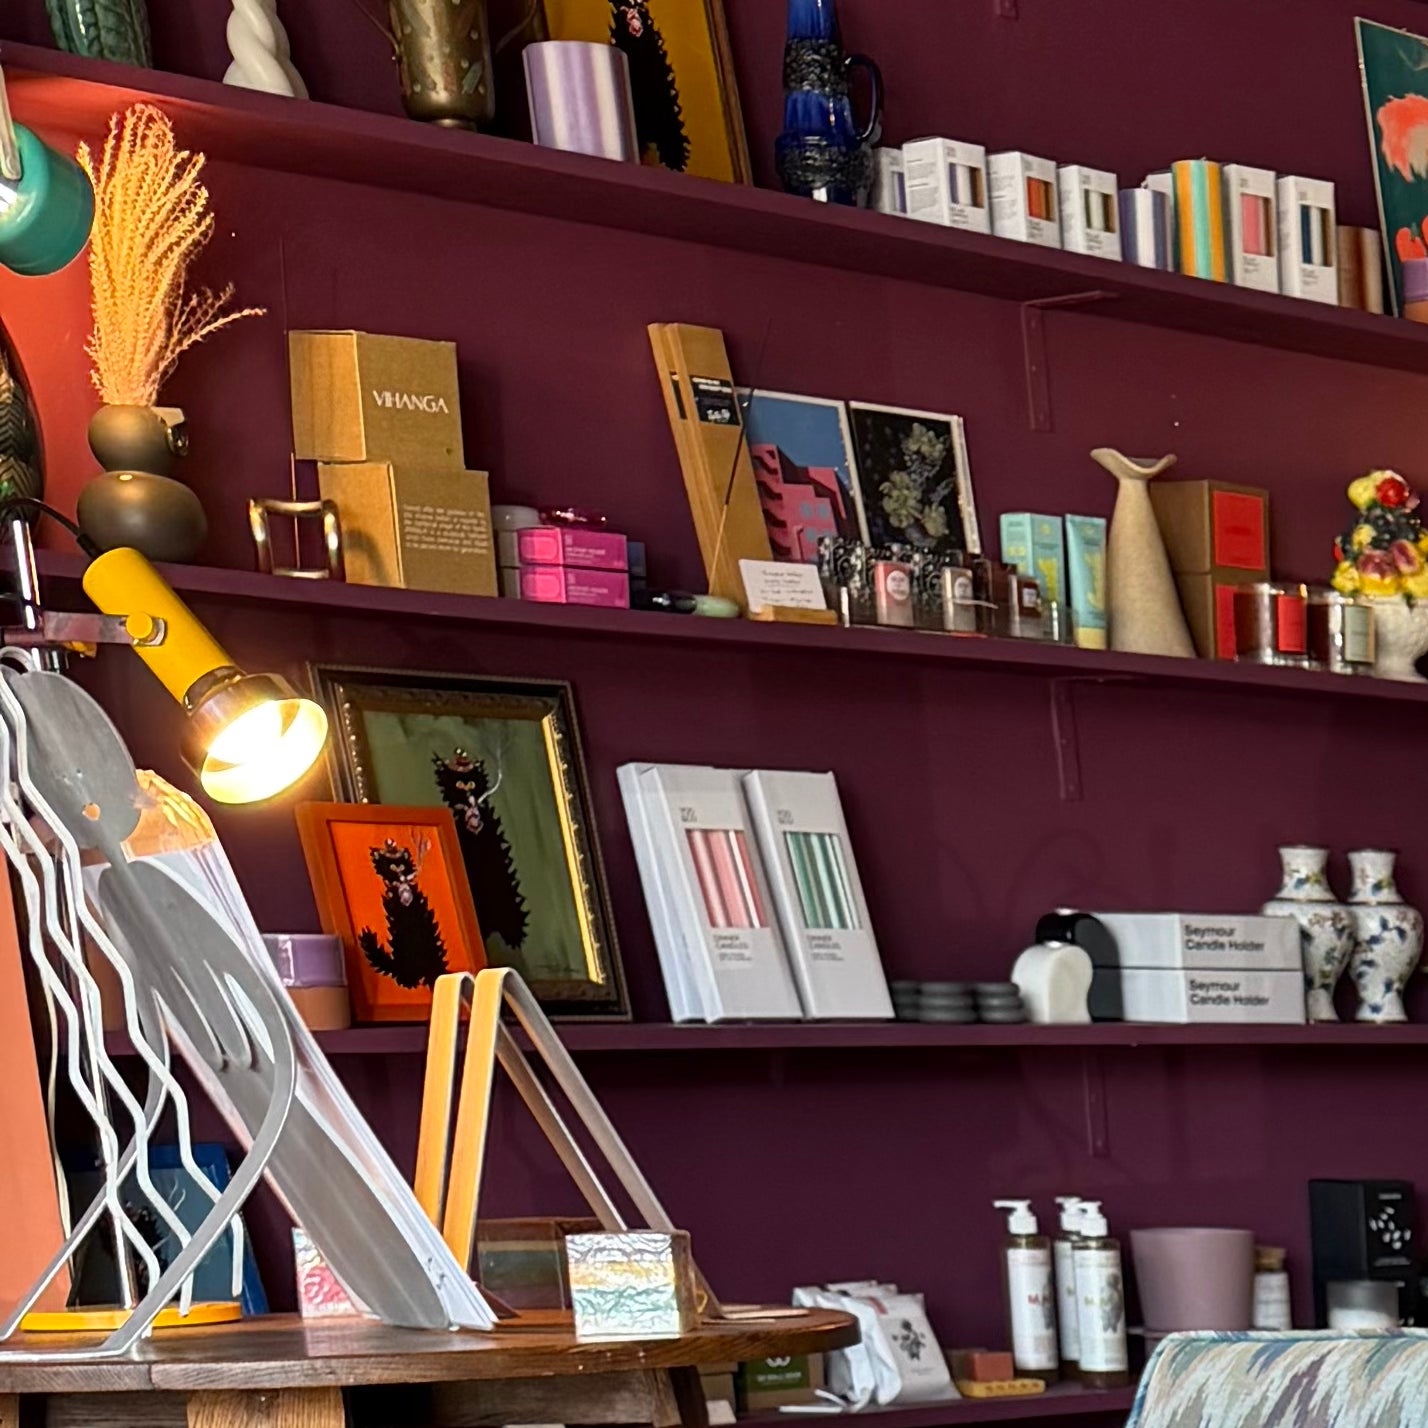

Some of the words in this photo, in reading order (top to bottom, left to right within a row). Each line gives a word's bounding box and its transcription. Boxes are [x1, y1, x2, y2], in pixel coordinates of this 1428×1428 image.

[372, 390, 449, 414] VIHANGA
[1184, 924, 1236, 939] Seymour
[1185, 939, 1226, 951] Candle
[1189, 979, 1241, 993] Seymour
[1190, 993, 1231, 1006] Candle
